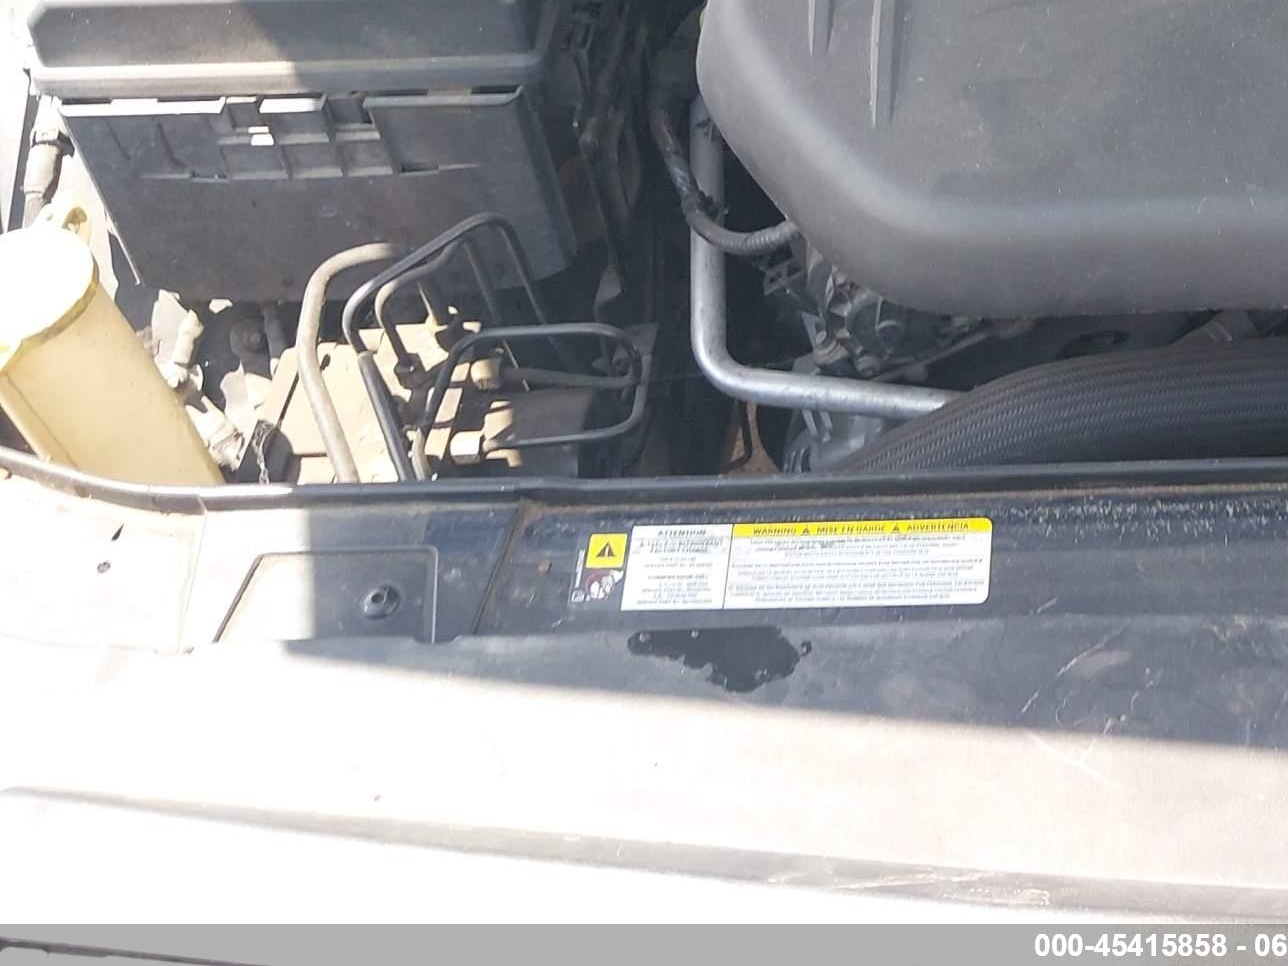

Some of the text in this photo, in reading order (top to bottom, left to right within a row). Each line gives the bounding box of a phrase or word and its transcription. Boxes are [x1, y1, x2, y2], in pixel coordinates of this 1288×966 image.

[752, 522, 970, 535] WARNING MISE EN GARDE ADVERTENCIA
